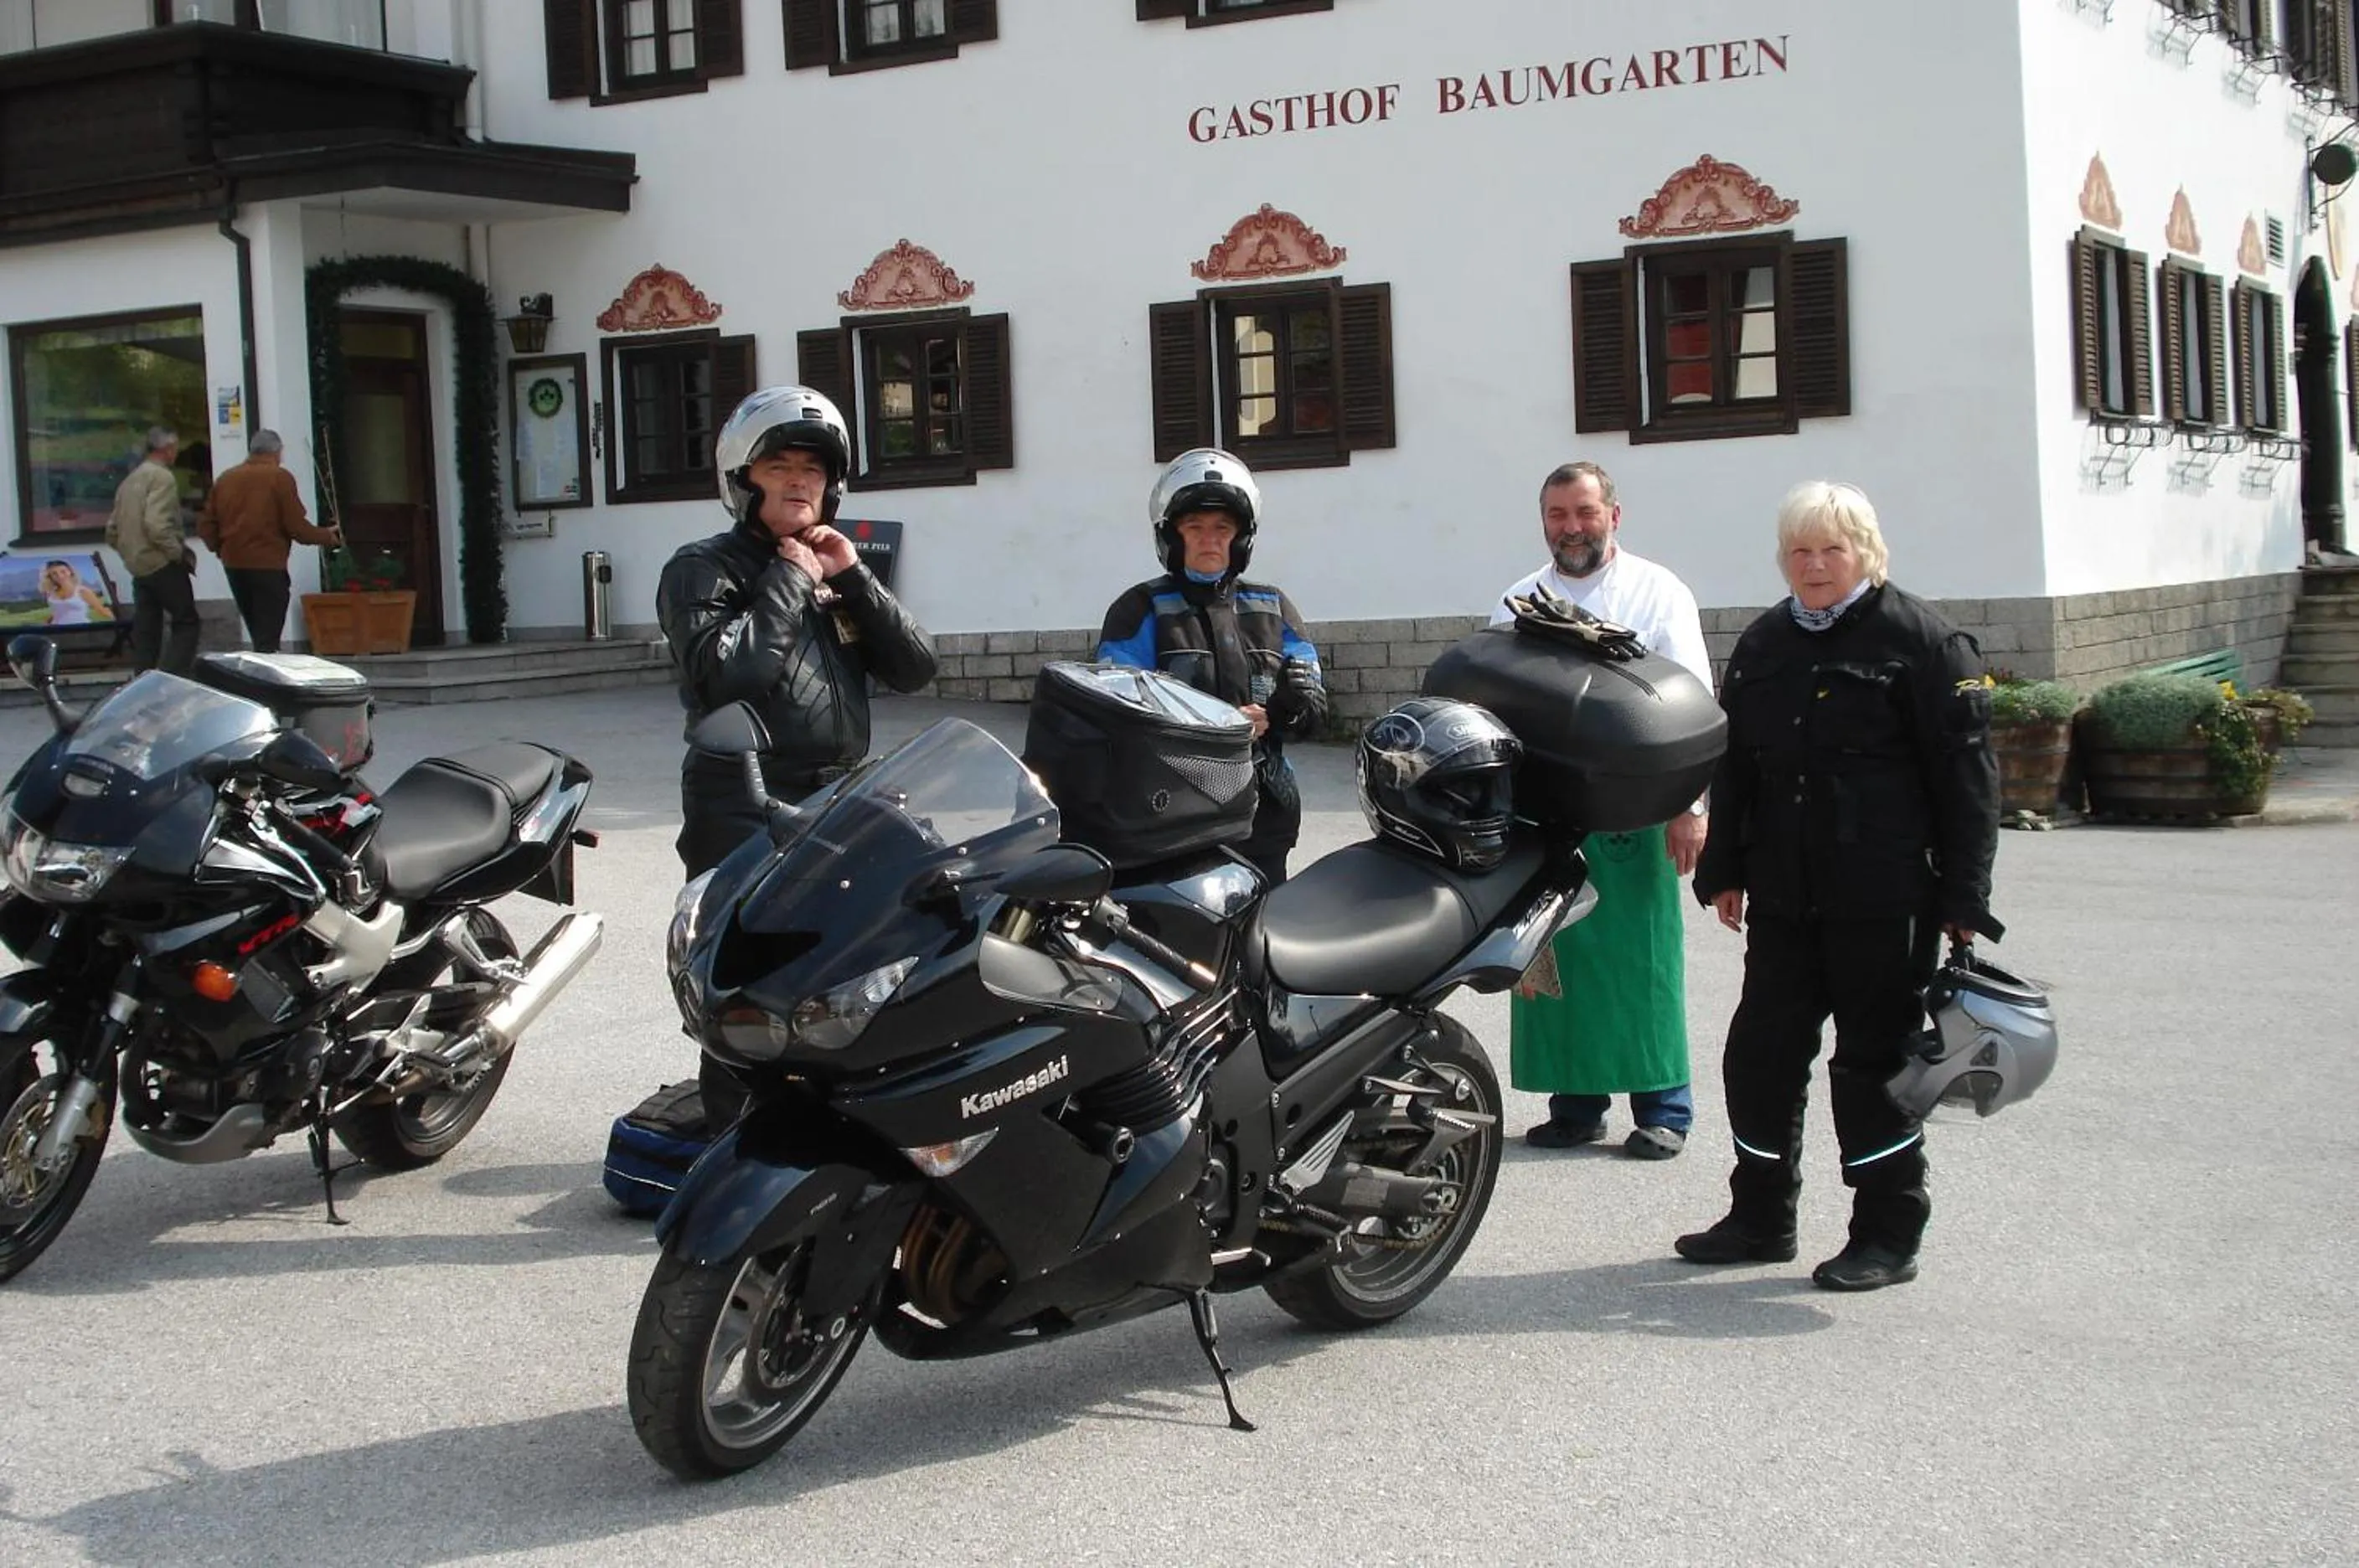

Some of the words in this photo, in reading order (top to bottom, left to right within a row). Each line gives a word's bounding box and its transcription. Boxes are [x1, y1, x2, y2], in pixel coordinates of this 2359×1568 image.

[1188, 84, 1401, 143] GASTHOF
[1437, 34, 1791, 114] BAUMGARTEN
[961, 1055, 1069, 1119] Kawasaki
